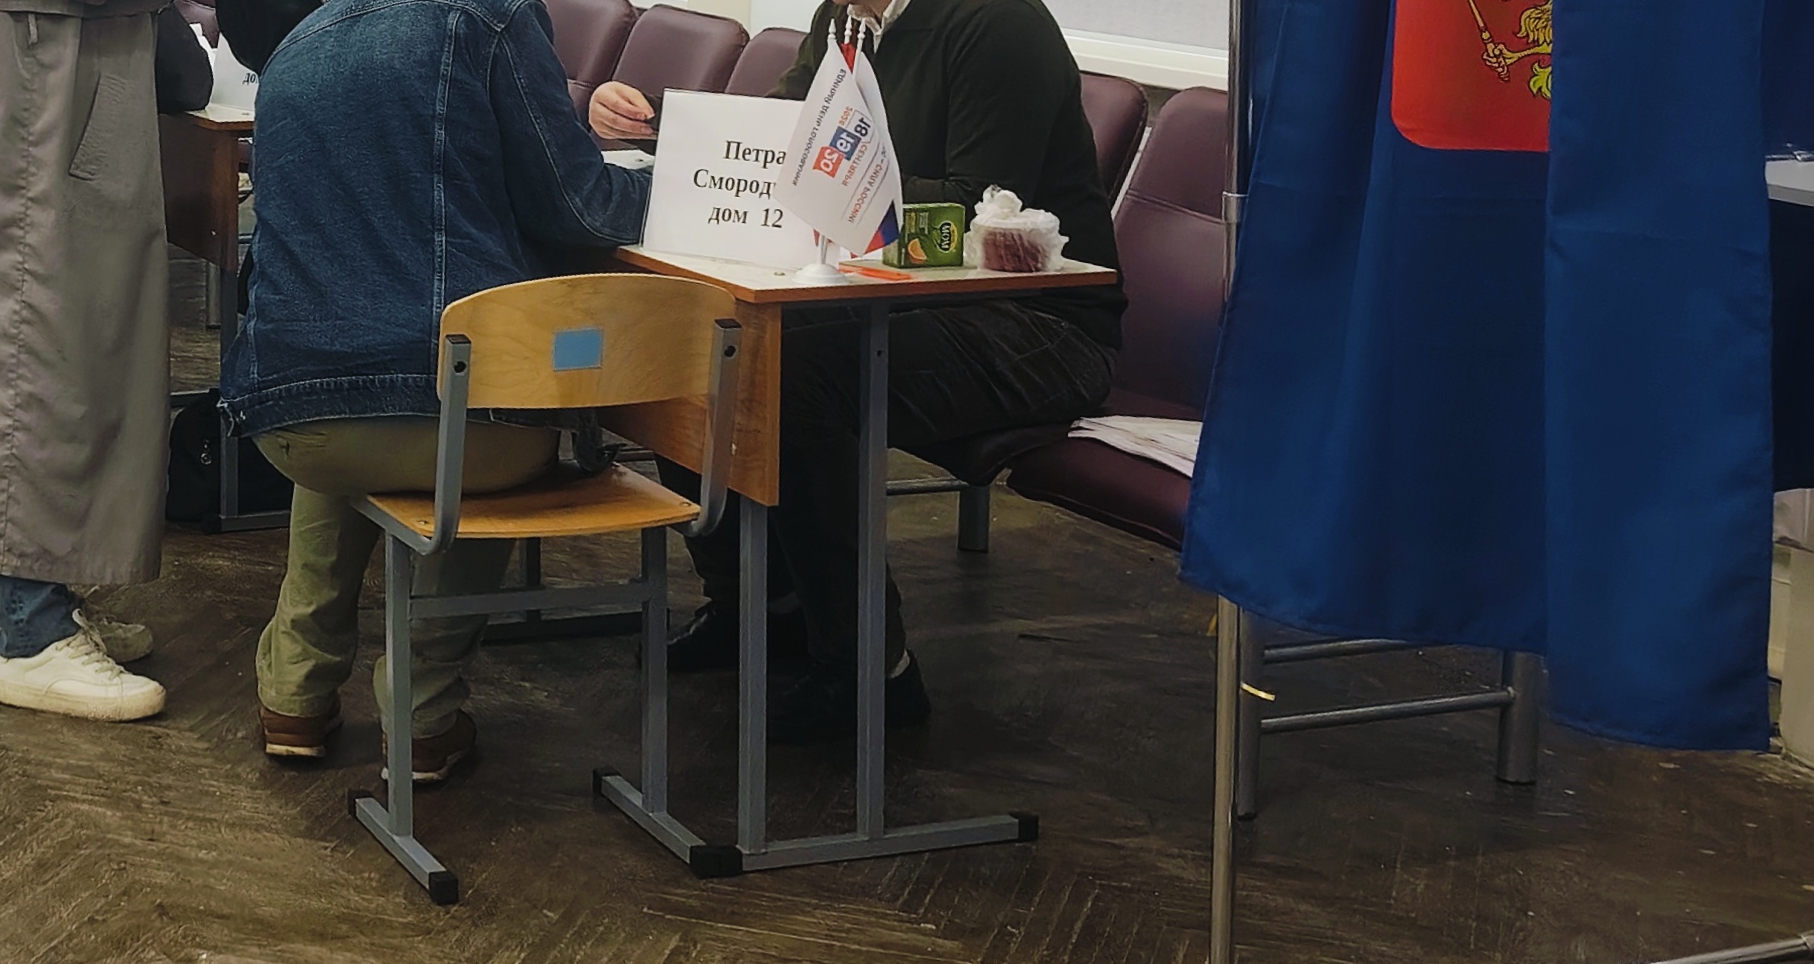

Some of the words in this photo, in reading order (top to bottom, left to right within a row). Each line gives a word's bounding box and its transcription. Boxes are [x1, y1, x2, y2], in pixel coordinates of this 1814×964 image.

[722, 139, 787, 169] Петра
[693, 168, 777, 200] Смород
[707, 206, 749, 226] дом
[760, 207, 785, 229] 12
